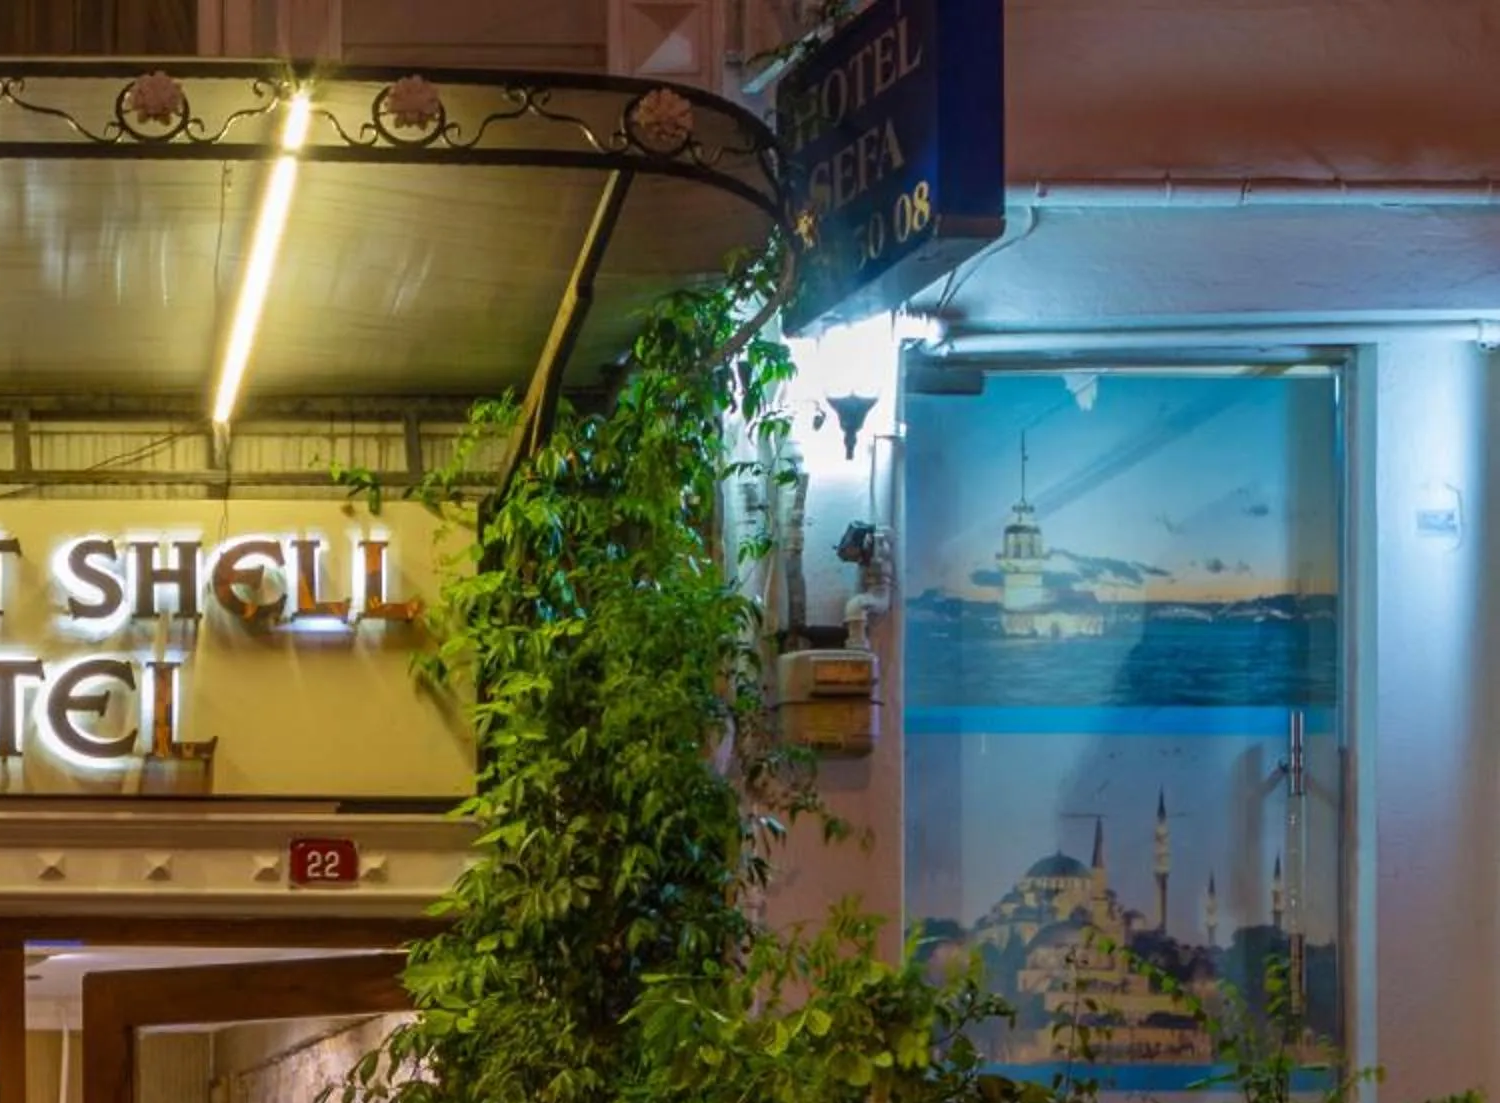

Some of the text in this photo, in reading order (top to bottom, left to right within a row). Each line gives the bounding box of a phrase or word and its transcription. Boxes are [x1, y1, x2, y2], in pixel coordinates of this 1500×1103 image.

[794, 14, 924, 151] HOTEL
[894, 180, 931, 243] 08
[66, 538, 426, 620] SHELL
[307, 850, 340, 878] 22
